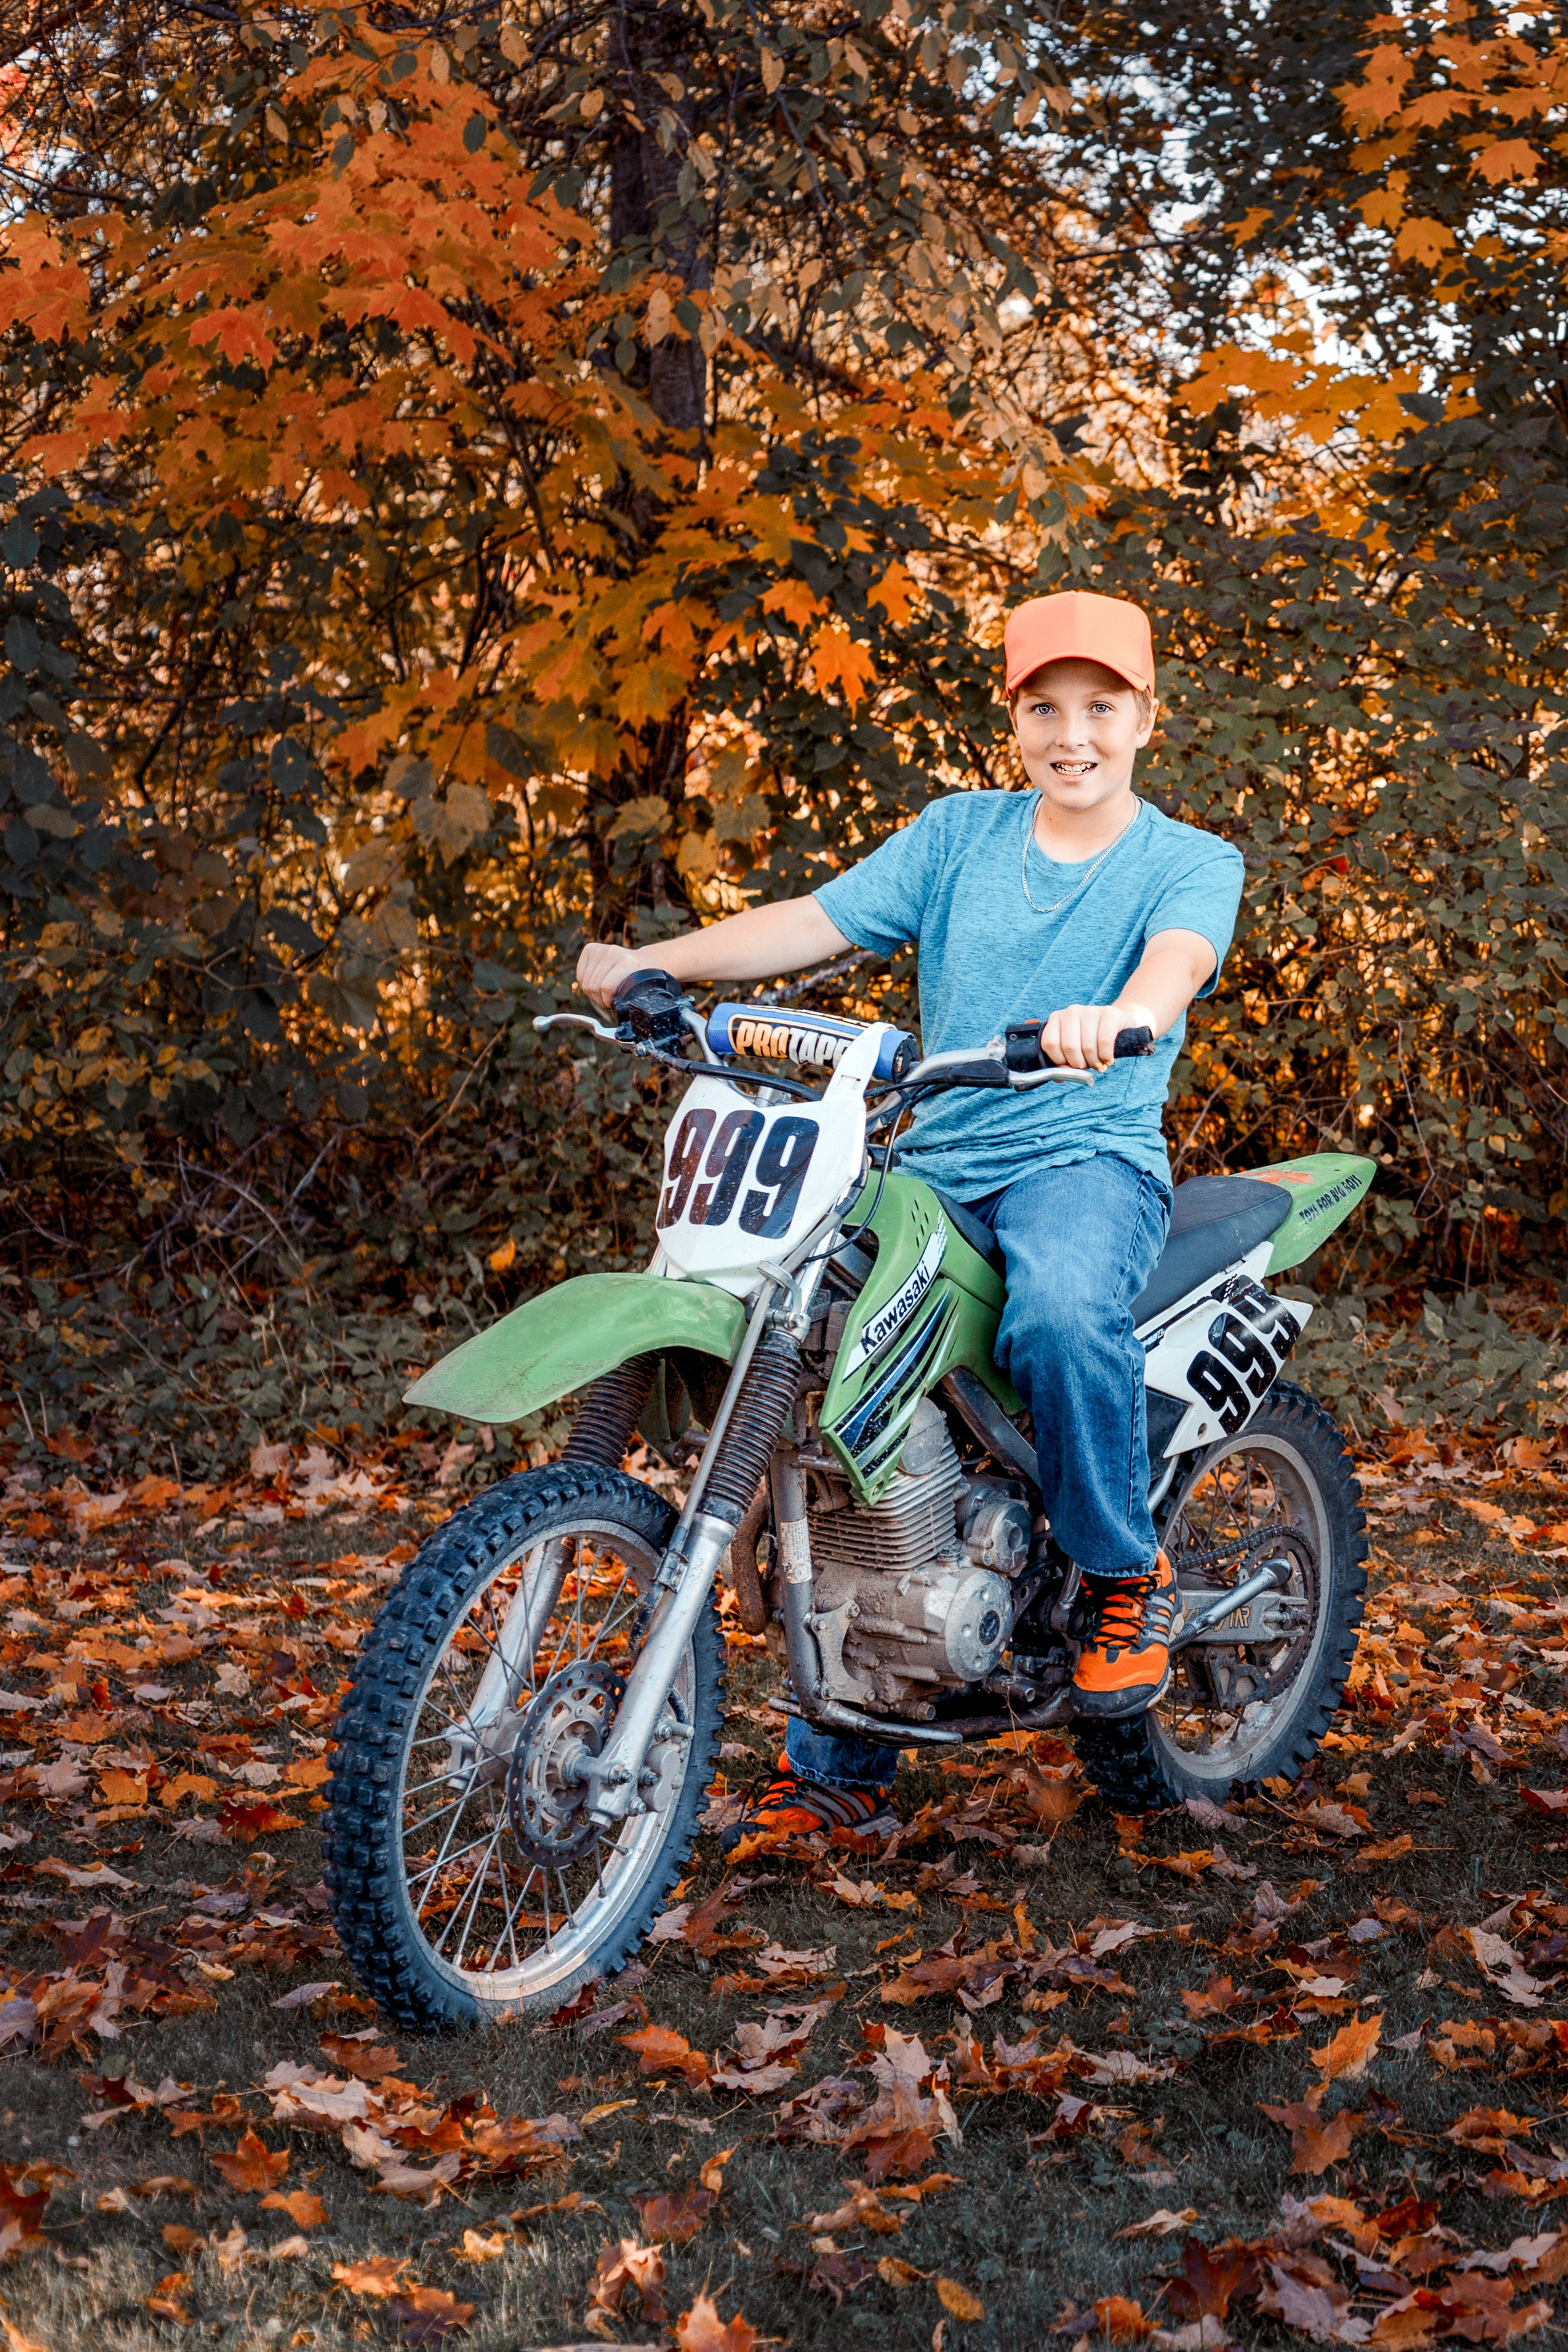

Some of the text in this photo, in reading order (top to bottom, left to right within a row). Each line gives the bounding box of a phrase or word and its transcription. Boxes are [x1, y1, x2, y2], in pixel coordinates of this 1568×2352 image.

[657, 1109, 819, 1239] 999
[1299, 1175, 1362, 1224] TOYS FOR BIG BOYS
[861, 1260, 930, 1355] Kawasaki
[1186, 1275, 1301, 1436] 999
